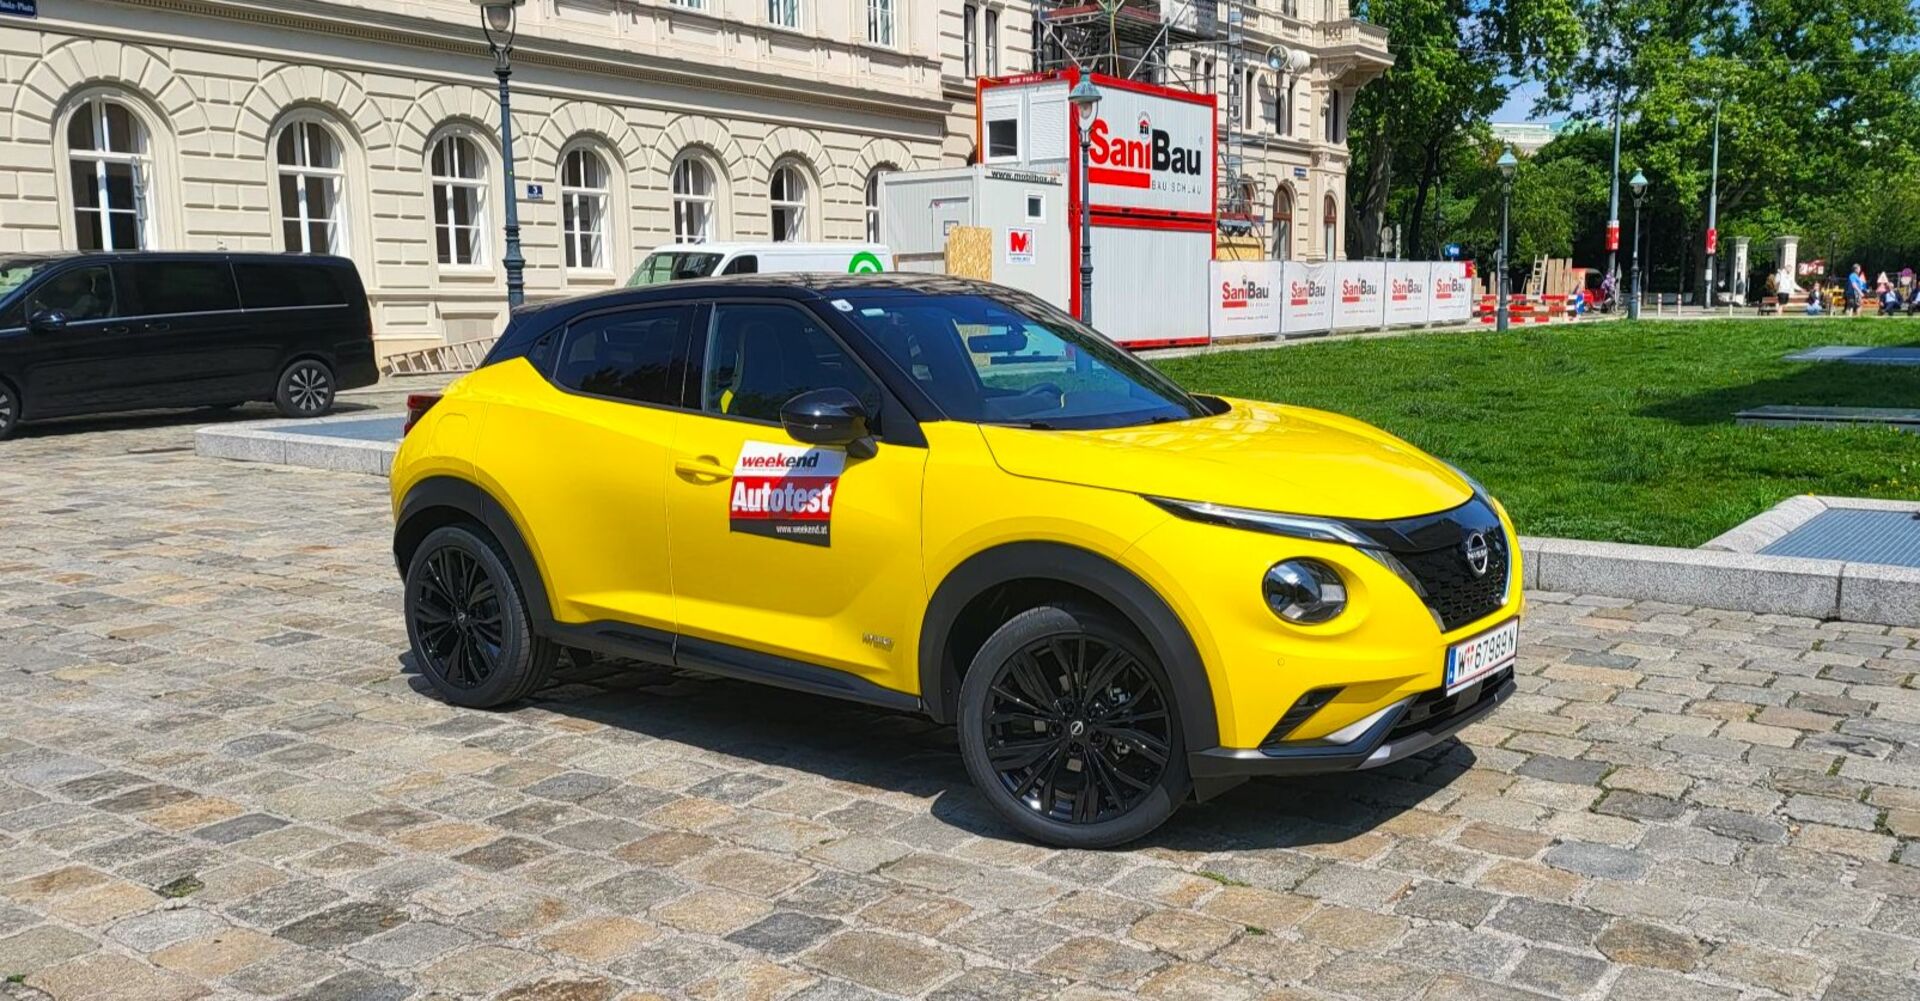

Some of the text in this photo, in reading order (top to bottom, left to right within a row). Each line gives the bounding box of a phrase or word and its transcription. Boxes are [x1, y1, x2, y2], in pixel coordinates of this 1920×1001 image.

[1089, 118, 1202, 176] SaniBau
[1222, 281, 1269, 300] SaniBau
[1291, 281, 1326, 298] SaniBau
[1342, 279, 1377, 295] SaniBau
[1392, 278, 1422, 294] SaniBau
[1436, 278, 1465, 292] SaniBau
[742, 452, 819, 468] weekend
[731, 481, 832, 513] Autotest
[776, 525, 827, 535] www.weekend.at
[1458, 651, 1465, 678] W
